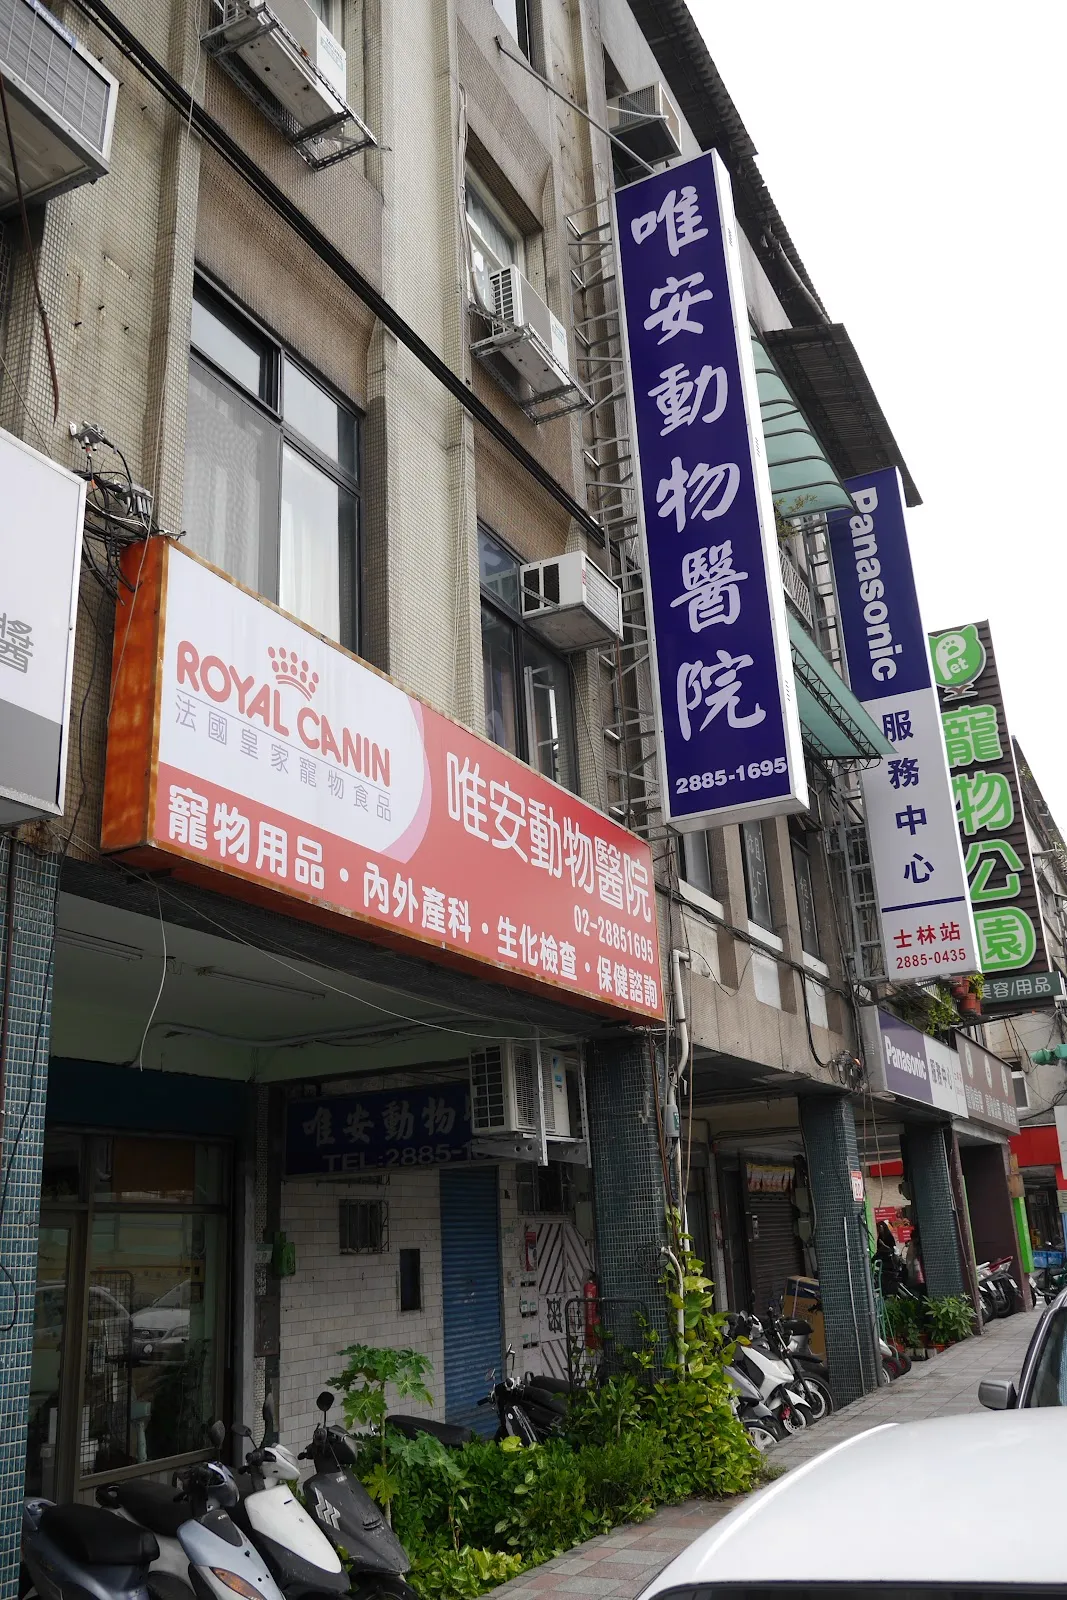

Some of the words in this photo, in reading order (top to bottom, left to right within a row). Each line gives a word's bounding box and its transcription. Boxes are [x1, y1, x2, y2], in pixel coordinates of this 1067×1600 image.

[631, 186, 766, 741] 唯安動物醫院
[849, 486, 903, 682] Panasonic
[175, 694, 392, 822] 法國皇家寵物食品
[176, 640, 290, 738] ROYAL
[297, 706, 391, 787] CANIN
[676, 756, 788, 794] 2885-1695
[446, 751, 652, 923] 唯安動物醫院
[882, 709, 934, 884] 服務中心
[941, 703, 1036, 973] 寵物公園
[167, 784, 325, 890] 寵物用品
[497, 915, 578, 981] 生化檢查
[596, 955, 658, 1010] 保健諮詢
[573, 904, 654, 964] 02-28851695
[893, 921, 961, 949] 士林站
[895, 948, 966, 969] 2885-0435
[302, 1092, 472, 1148] 唯安動物
[884, 1035, 927, 1081] Panasonic
